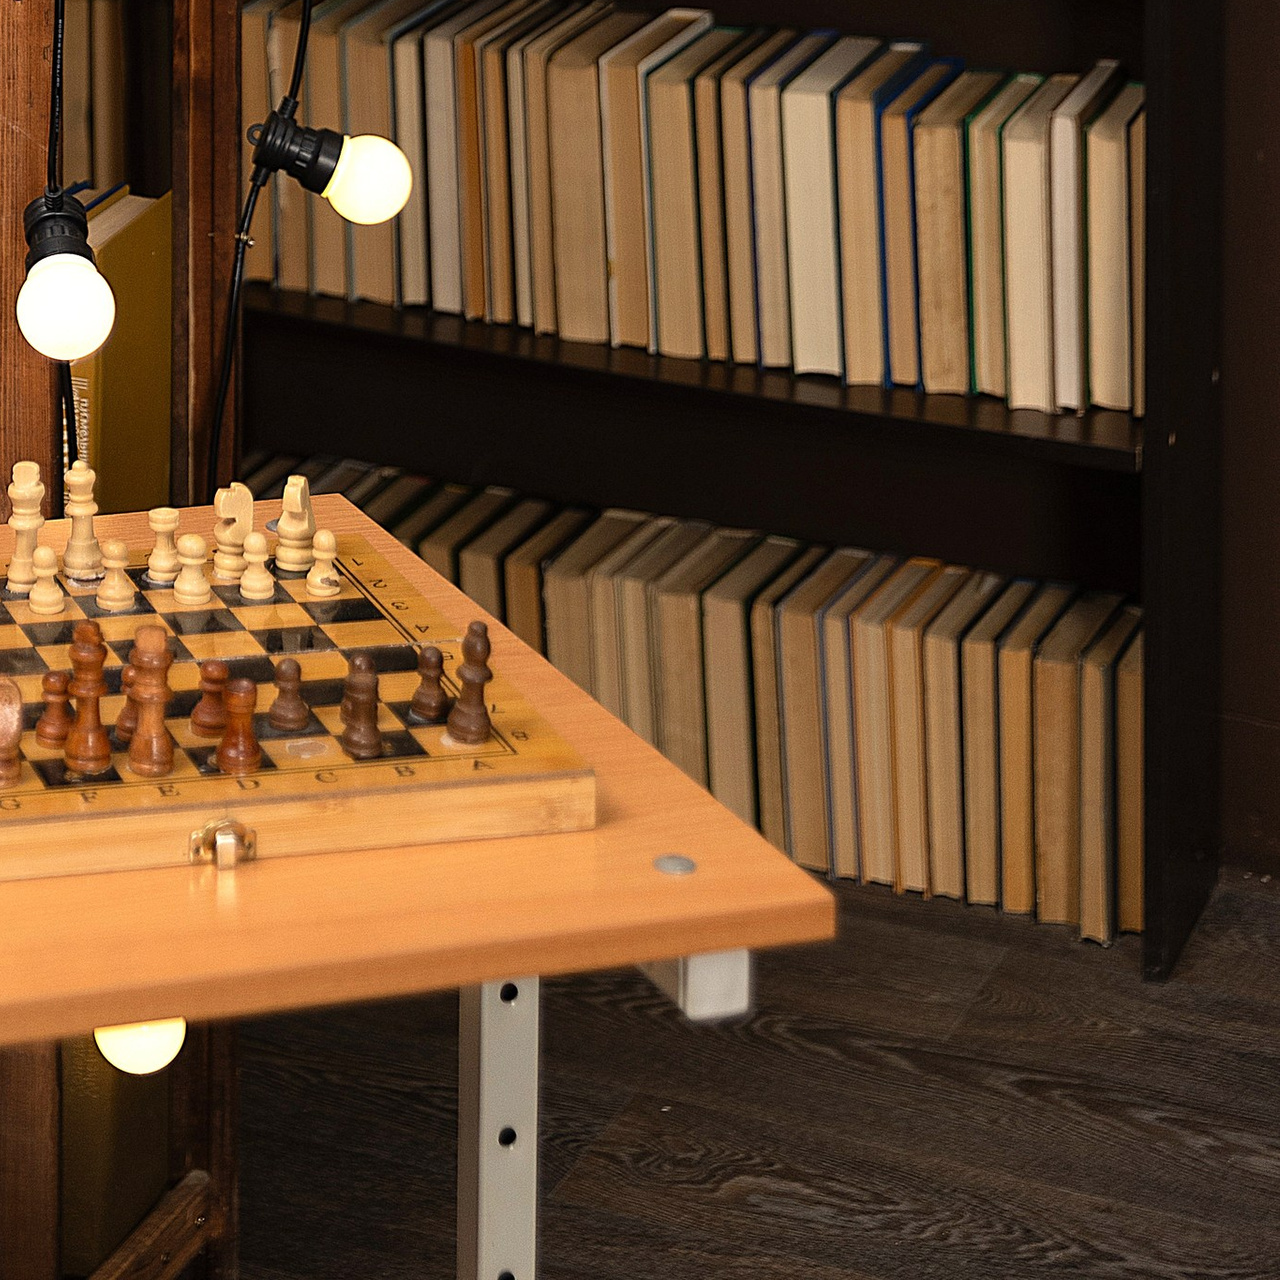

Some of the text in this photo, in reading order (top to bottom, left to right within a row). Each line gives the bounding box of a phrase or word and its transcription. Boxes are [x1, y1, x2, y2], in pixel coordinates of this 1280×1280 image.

[79, 791, 101, 805] F
[157, 784, 181, 798] E
[236, 777, 261, 791] D
[314, 771, 339, 784] C
[393, 765, 416, 778] B
[472, 758, 495, 771] A
